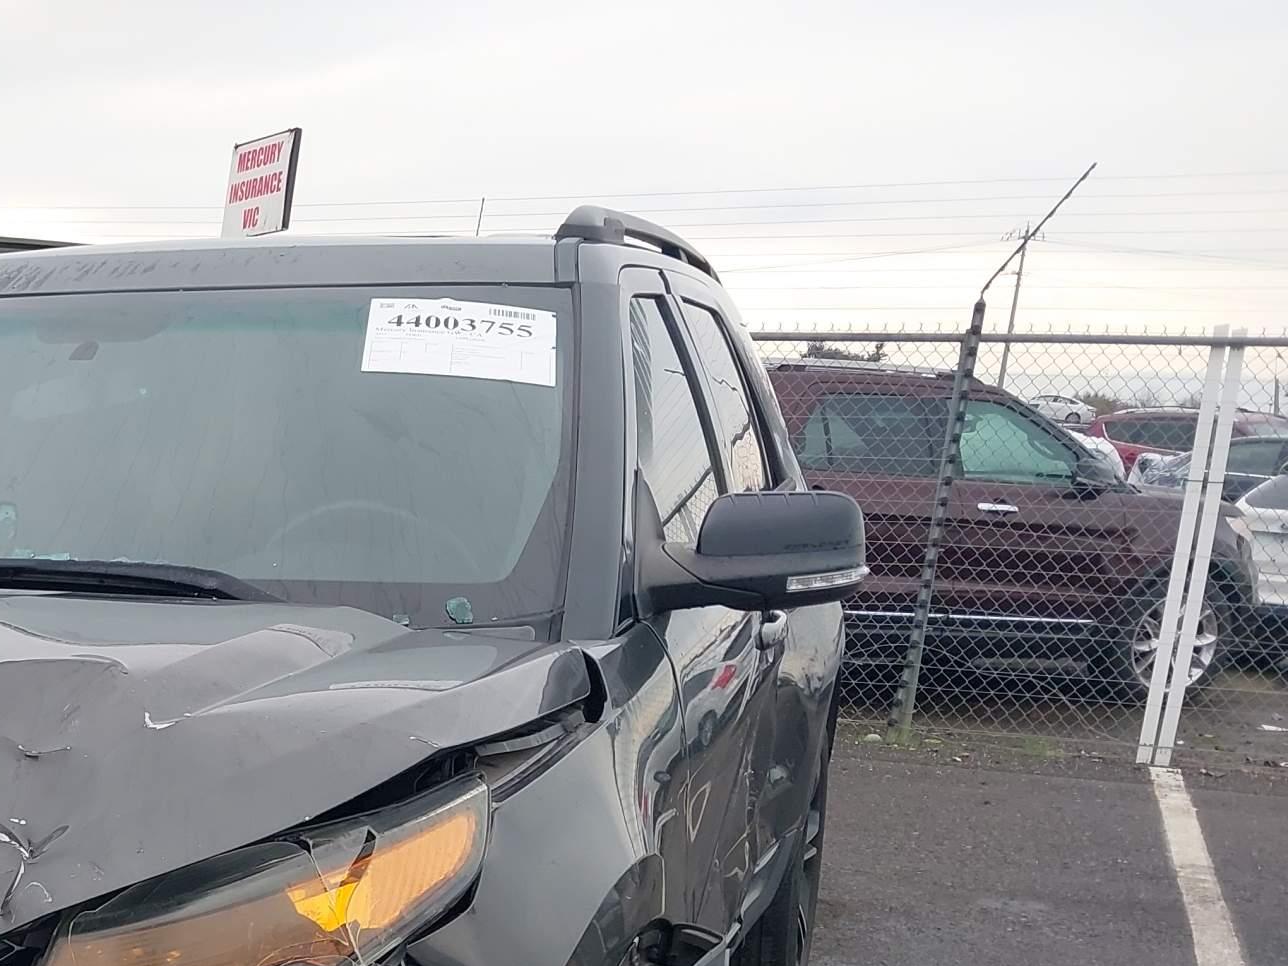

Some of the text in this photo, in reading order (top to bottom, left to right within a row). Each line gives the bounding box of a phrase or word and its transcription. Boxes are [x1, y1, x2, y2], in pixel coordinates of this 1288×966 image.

[237, 141, 284, 173] MERCURY
[229, 171, 283, 204] INSURANCE
[243, 206, 259, 229] VIC
[388, 314, 534, 338] 44003755
